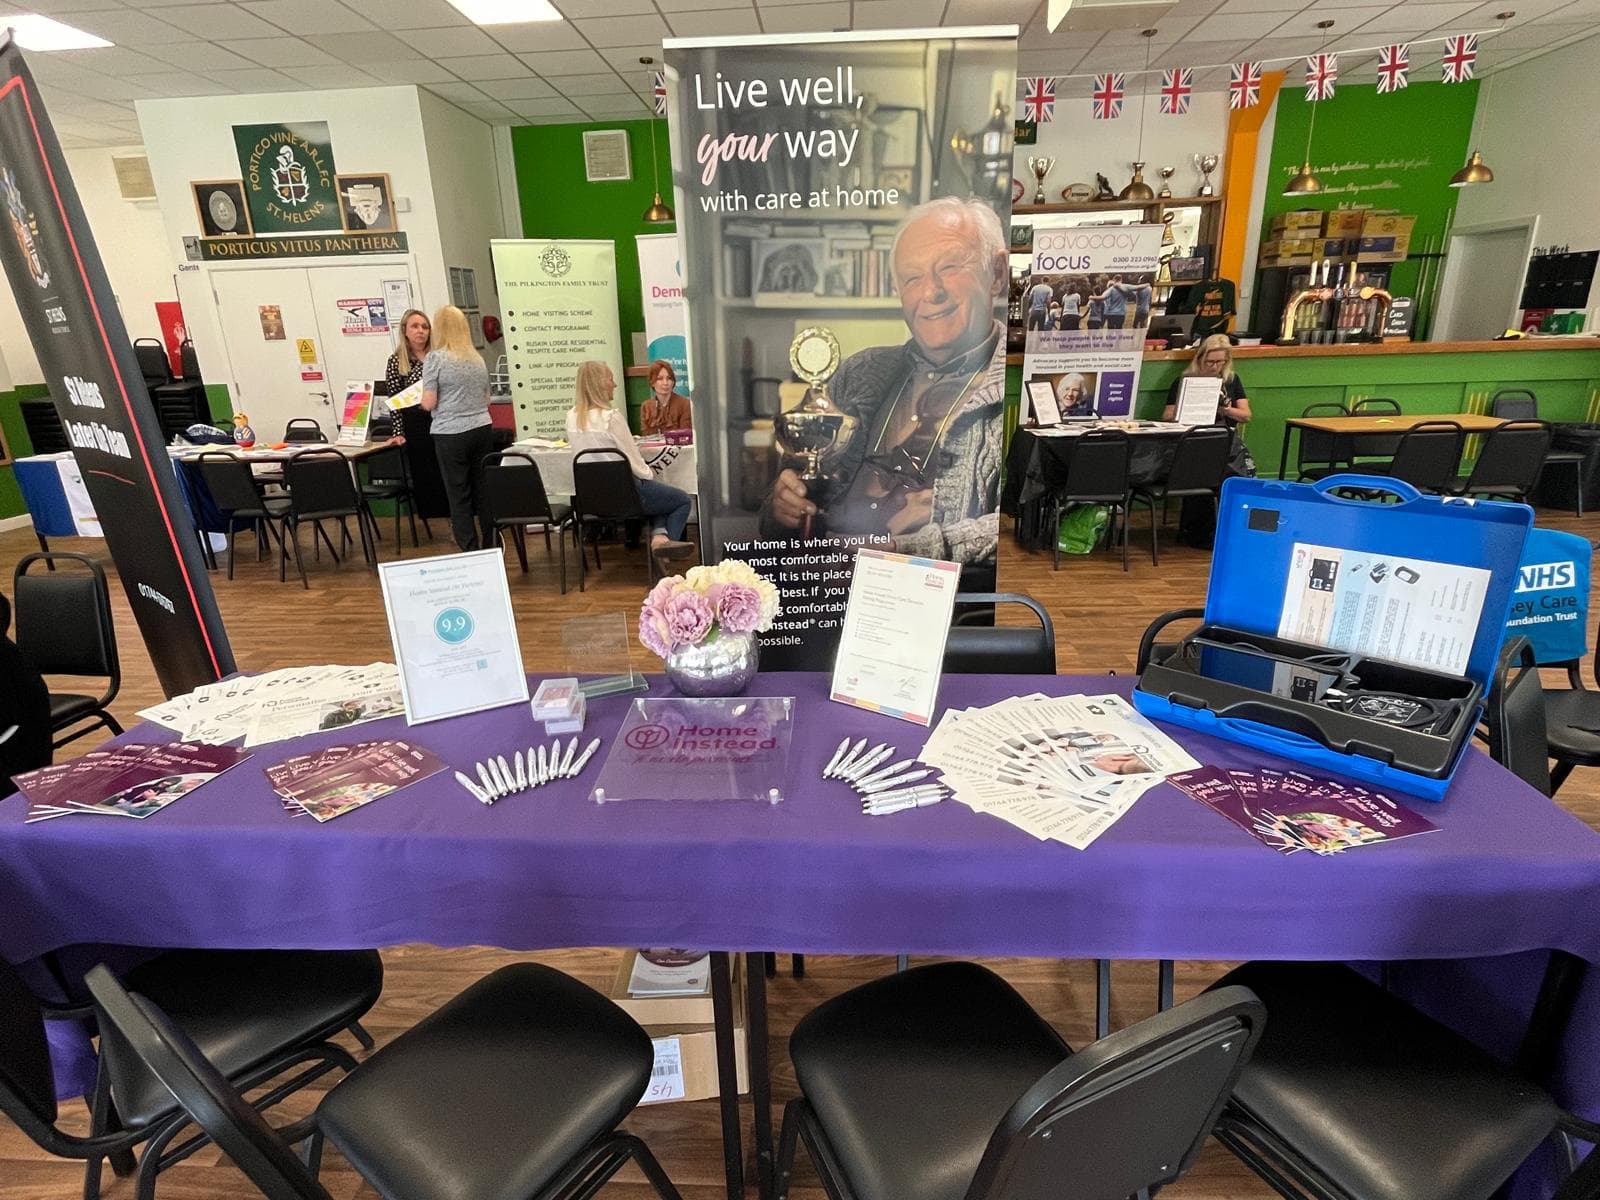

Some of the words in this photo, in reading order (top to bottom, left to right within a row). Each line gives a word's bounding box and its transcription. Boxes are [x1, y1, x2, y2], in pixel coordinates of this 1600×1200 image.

[695, 72, 768, 110] Live
[779, 66, 864, 110] well,
[251, 137, 271, 191] PORTICO
[270, 132, 298, 145] VINE
[696, 131, 779, 186] your
[784, 127, 859, 167] way
[700, 189, 749, 213] with
[755, 190, 802, 210] care
[808, 187, 830, 208] at
[836, 185, 900, 206] home
[283, 200, 326, 224] HELENS
[209, 240, 278, 256] PORTICUS
[279, 239, 322, 253] VITUS
[325, 237, 400, 252] PANTHERA
[1038, 232, 1141, 252] advocacy
[1036, 252, 1092, 271] focus
[724, 541, 751, 551] Your
[754, 539, 787, 550] home
[791, 538, 800, 548] is
[804, 537, 840, 548] where
[844, 536, 866, 548] you
[869, 533, 891, 545] feel
[749, 556, 778, 567] most
[780, 553, 849, 566] comfortable
[779, 572, 787, 581] It
[790, 571, 799, 580] is
[802, 570, 820, 581] the
[823, 570, 852, 582] place
[1520, 564, 1571, 589] NHS
[782, 587, 809, 598] best.
[811, 586, 820, 596] If
[824, 587, 845, 599] you
[1541, 595, 1577, 609] Care
[441, 616, 466, 633] 9.9
[771, 618, 816, 630] nstead®
[818, 619, 837, 628] can
[1554, 612, 1578, 621] Trust
[677, 725, 758, 737] Home
[673, 737, 777, 750] Instead
